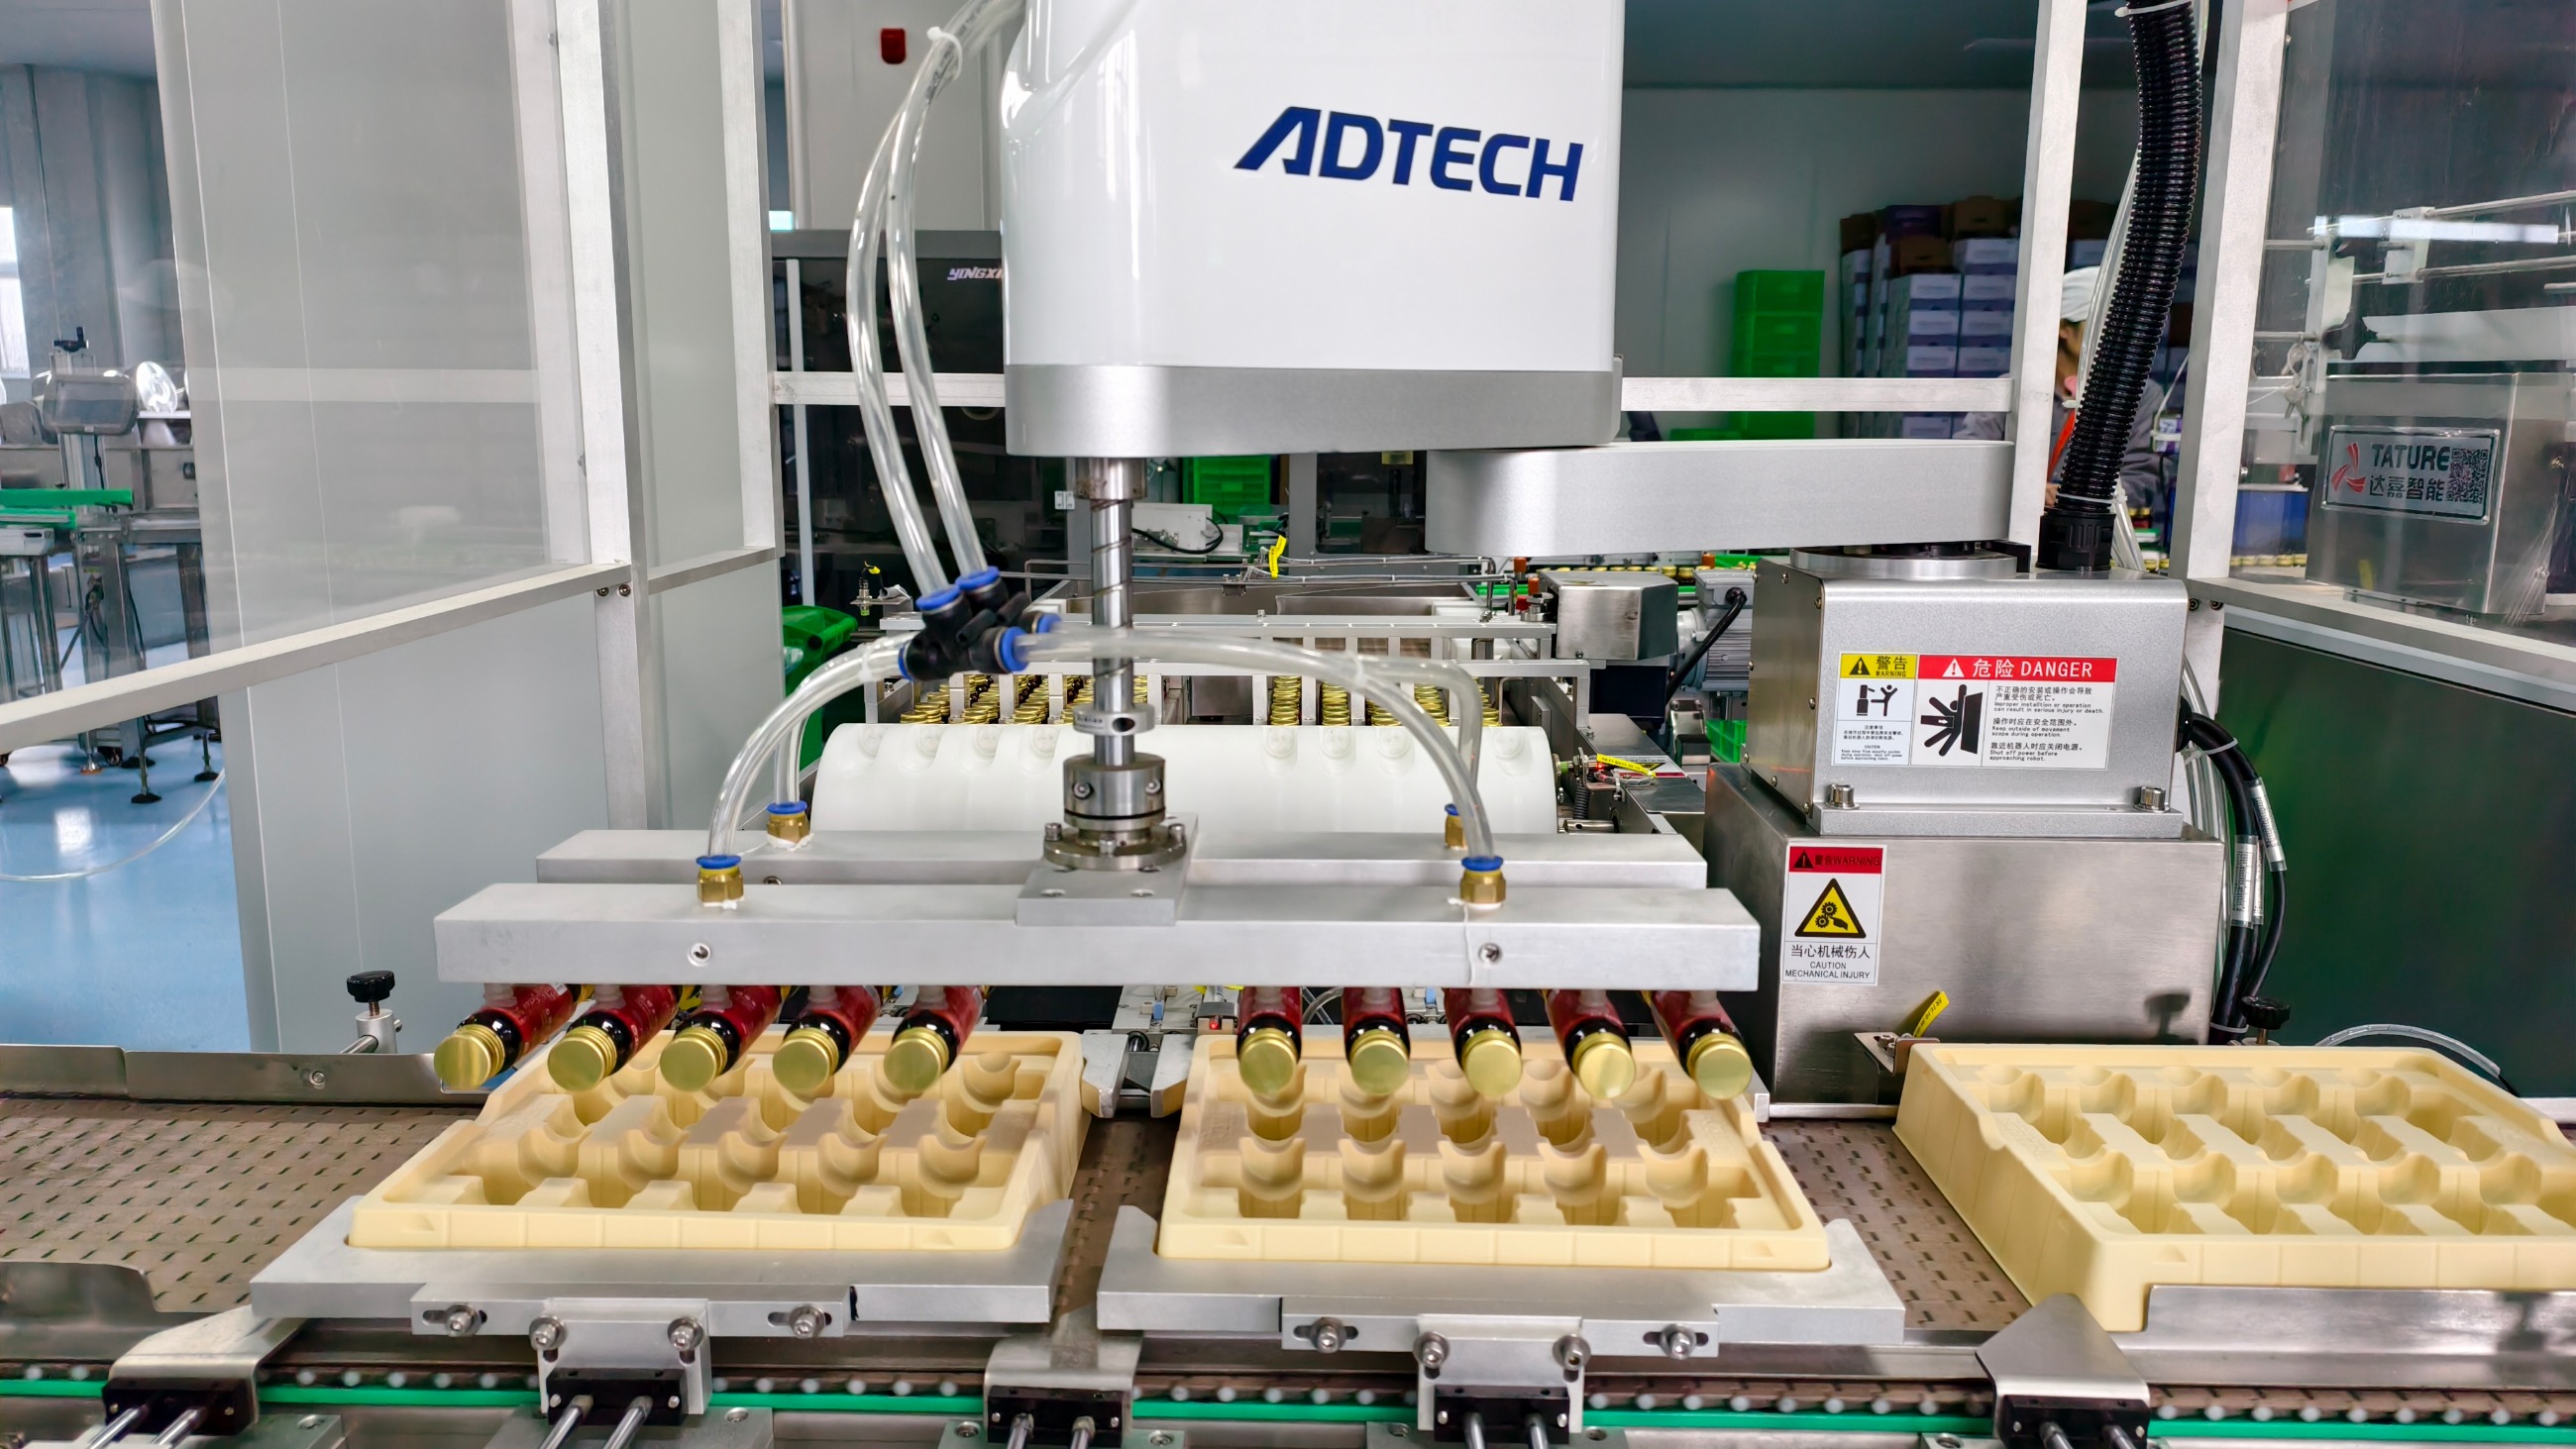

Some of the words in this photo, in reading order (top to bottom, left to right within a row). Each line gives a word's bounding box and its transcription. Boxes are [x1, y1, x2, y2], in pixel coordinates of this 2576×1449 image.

[1234, 106, 1583, 201] ADTECH
[2371, 444, 2450, 470] TATURE
[1876, 655, 1907, 671] 警告
[1972, 658, 2015, 677] 危险
[2020, 661, 2093, 677] DANGER
[1791, 944, 1870, 959] 当心机械伤人
[1785, 970, 1838, 978] MECHANICAL
